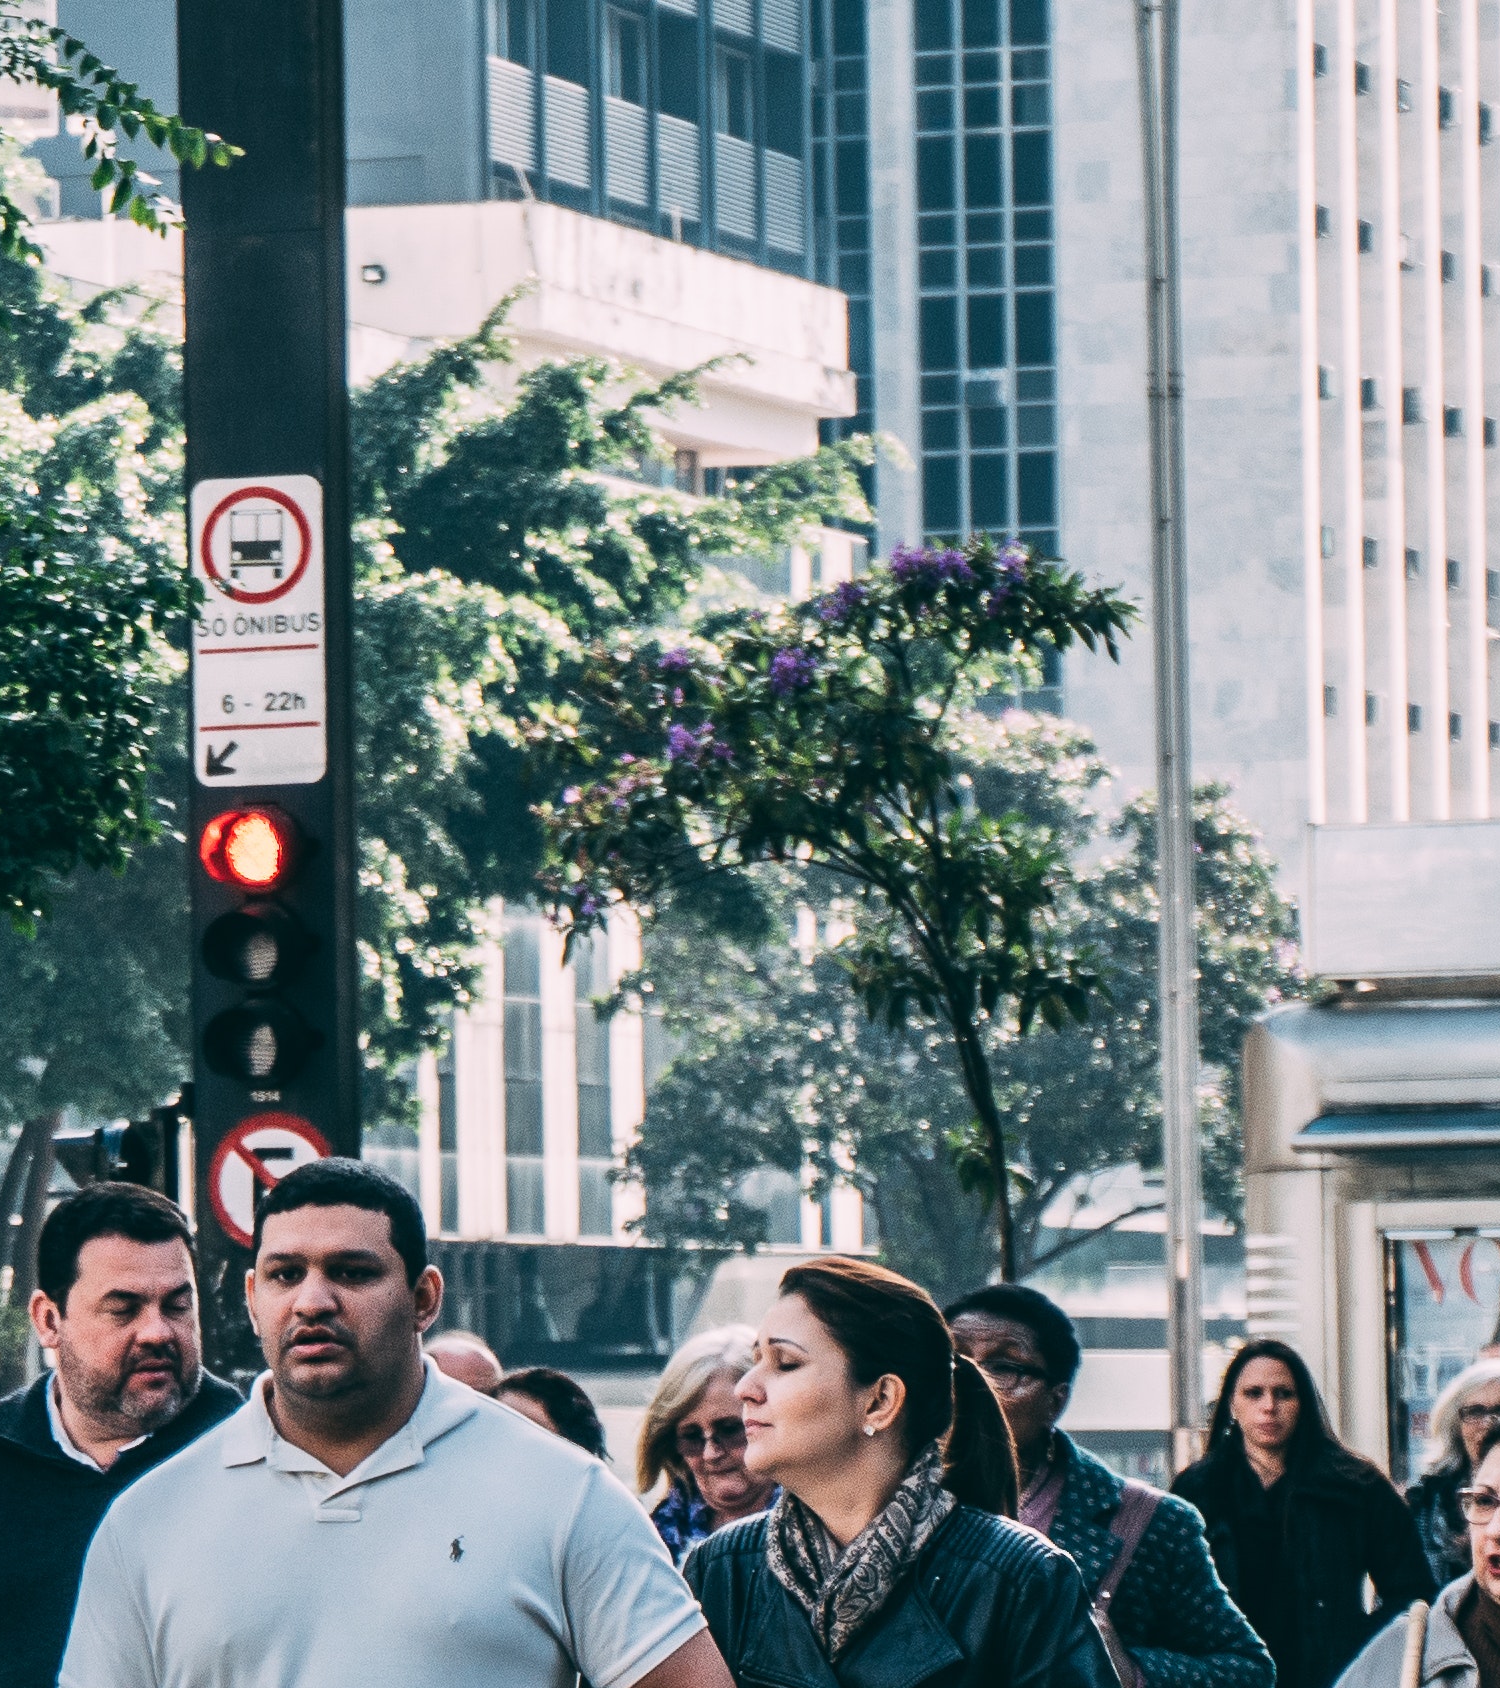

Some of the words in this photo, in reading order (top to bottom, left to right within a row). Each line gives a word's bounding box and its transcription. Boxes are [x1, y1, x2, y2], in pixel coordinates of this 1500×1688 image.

[233, 612, 320, 635] ÔNIBUS
[222, 694, 235, 714] 6
[264, 691, 306, 712] 22h
